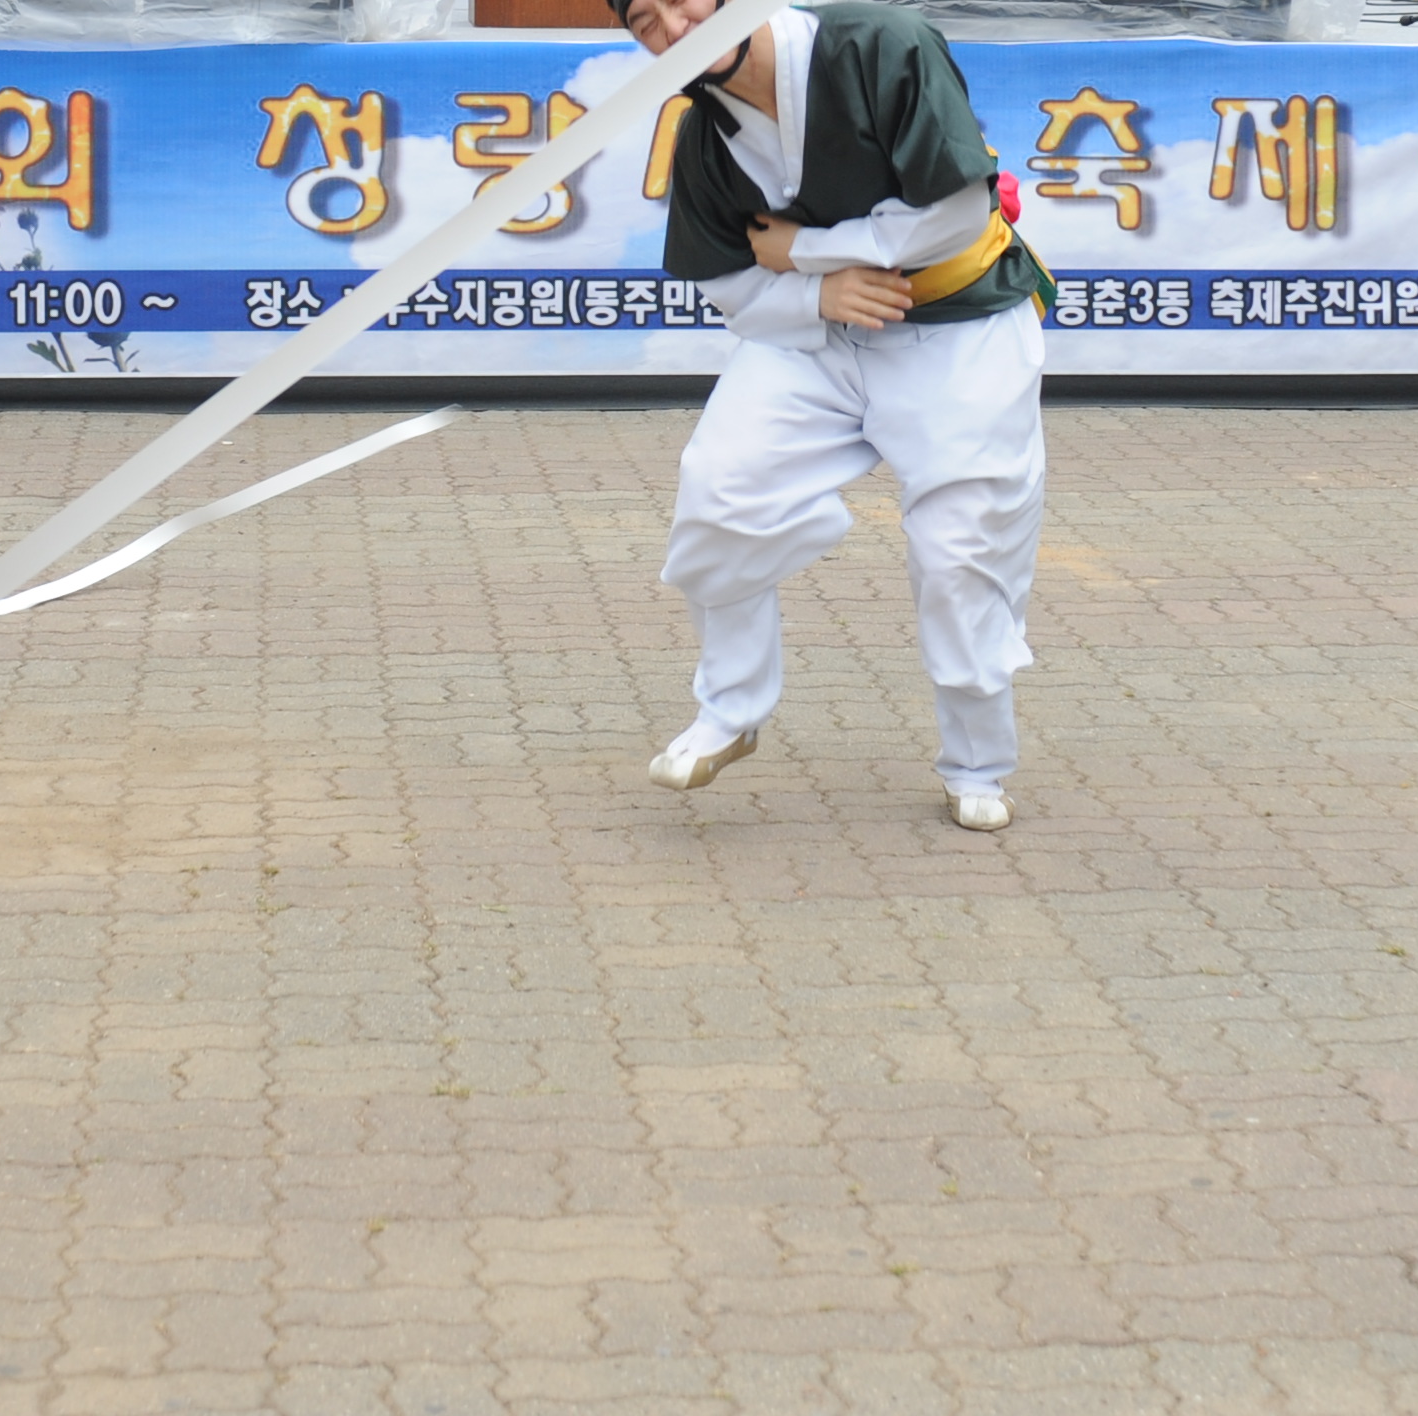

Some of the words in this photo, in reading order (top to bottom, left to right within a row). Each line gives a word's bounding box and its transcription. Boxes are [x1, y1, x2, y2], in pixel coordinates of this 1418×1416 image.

[9, 282, 122, 327] 11:00
[246, 279, 321, 328] 장소
[1054, 279, 1190, 327] 동춘3동
